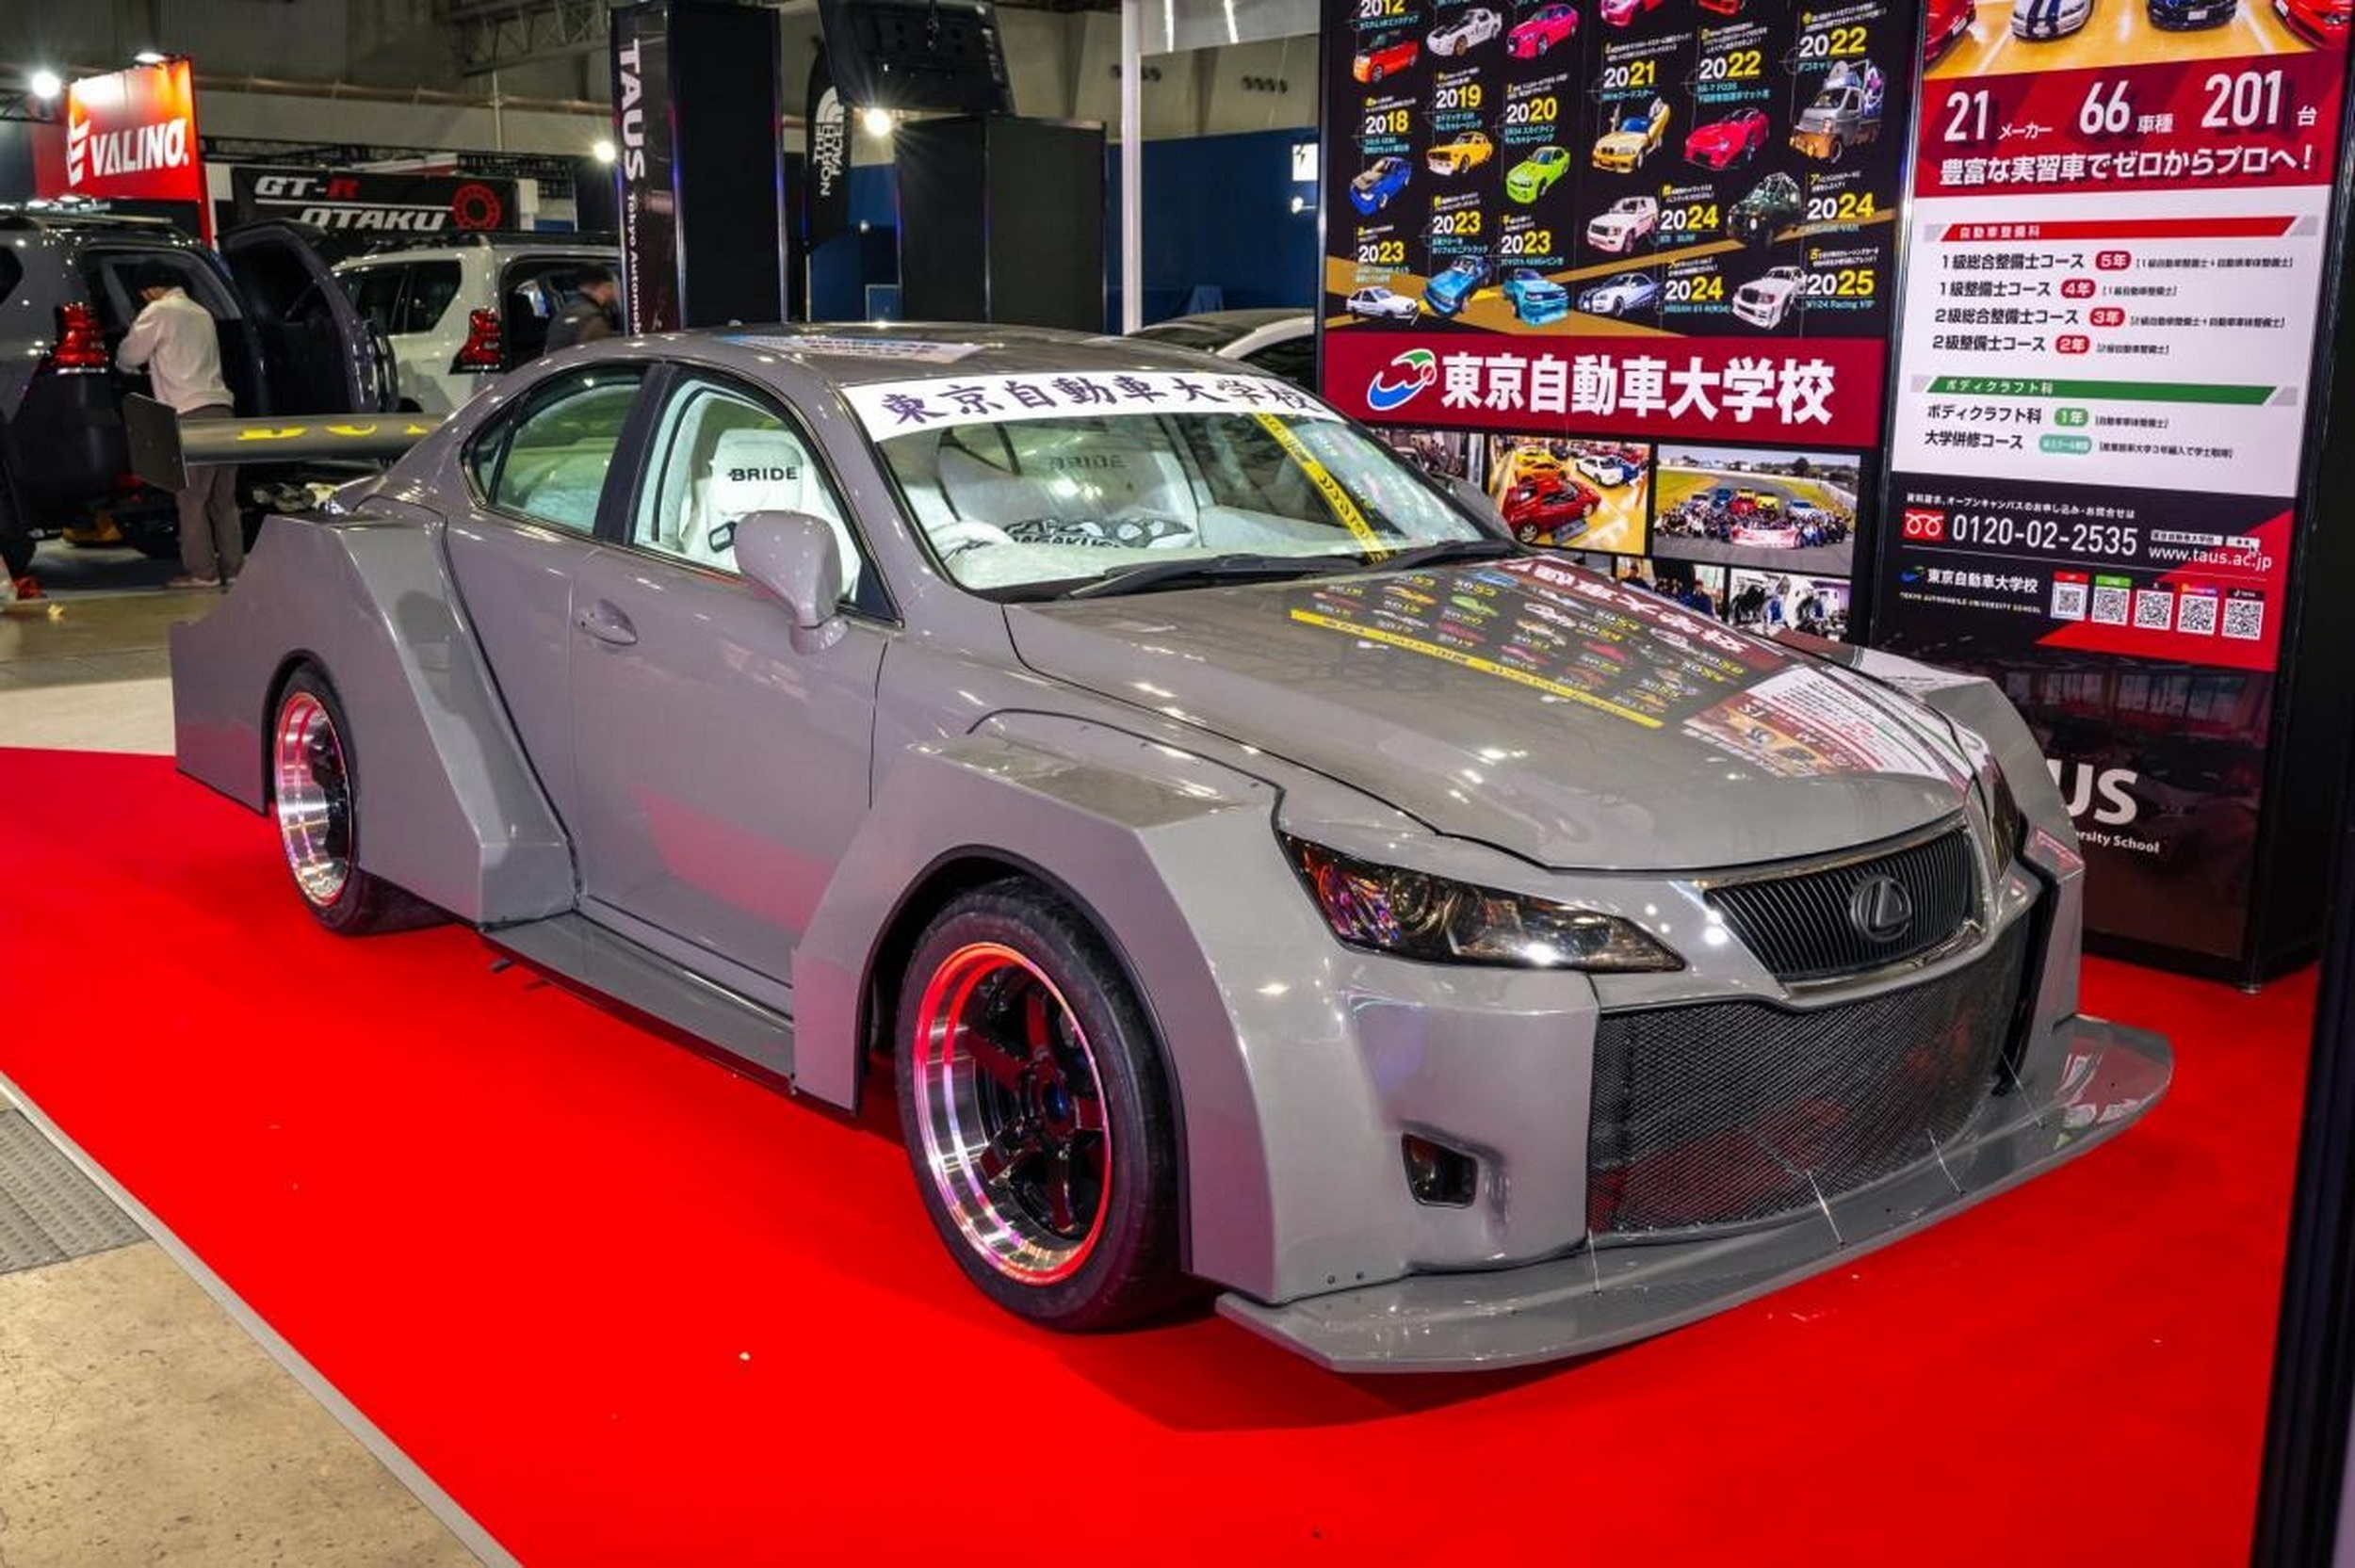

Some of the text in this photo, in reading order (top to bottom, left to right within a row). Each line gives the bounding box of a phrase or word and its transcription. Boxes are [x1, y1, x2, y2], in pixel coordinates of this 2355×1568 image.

[1798, 26, 1867, 57] 2022
[1603, 60, 1656, 89] 2021
[1699, 50, 1762, 81] 2022
[618, 39, 646, 179] TAUS
[1435, 84, 1483, 109] 2019
[1943, 70, 2318, 142] 21 メーカー 66 車種 201 台
[1364, 110, 1409, 135] 2018
[1505, 97, 1558, 124] 2020
[813, 125, 822, 165] THE
[832, 125, 844, 176] FACE
[820, 125, 833, 196] NORTH
[254, 175, 360, 201] GT-R
[300, 205, 447, 232] OTAKU
[627, 192, 638, 248] Tokyo
[1661, 204, 1720, 231] 2024
[1807, 193, 1876, 220] 2024
[1432, 211, 1482, 235] 2023
[1357, 240, 1405, 264] 2023
[1501, 231, 1552, 255] 2023
[1941, 253, 2084, 271] 1級総合整備士コース
[2100, 252, 2127, 269] 5年
[1665, 276, 1725, 302] 2024
[1807, 270, 1876, 297] 2025
[1939, 281, 2051, 298] 1級整備士コース
[2065, 281, 2091, 298] 4年
[1934, 309, 2079, 327] 2級総合整備士コース
[2093, 310, 2120, 326] 3年
[1932, 335, 2046, 353] 2級整備士コース
[2058, 337, 2086, 353] 2年
[881, 375, 1317, 426] 東京自動車大学校
[1441, 349, 1835, 427] 東京自動車大学校
[1945, 379, 2054, 395] ボディクラフト科
[1926, 405, 2042, 425] ボディクラフト科
[2061, 411, 2084, 425] 1年
[1924, 430, 2023, 450] 大学併修コース
[732, 465, 799, 482] BRIDE
[1952, 513, 2138, 558] 0120-02-2535
[2148, 546, 2273, 573] www.taus.ac.jp
[1927, 568, 2038, 594] 東京自動車大学校
[2113, 835, 2160, 854] School
